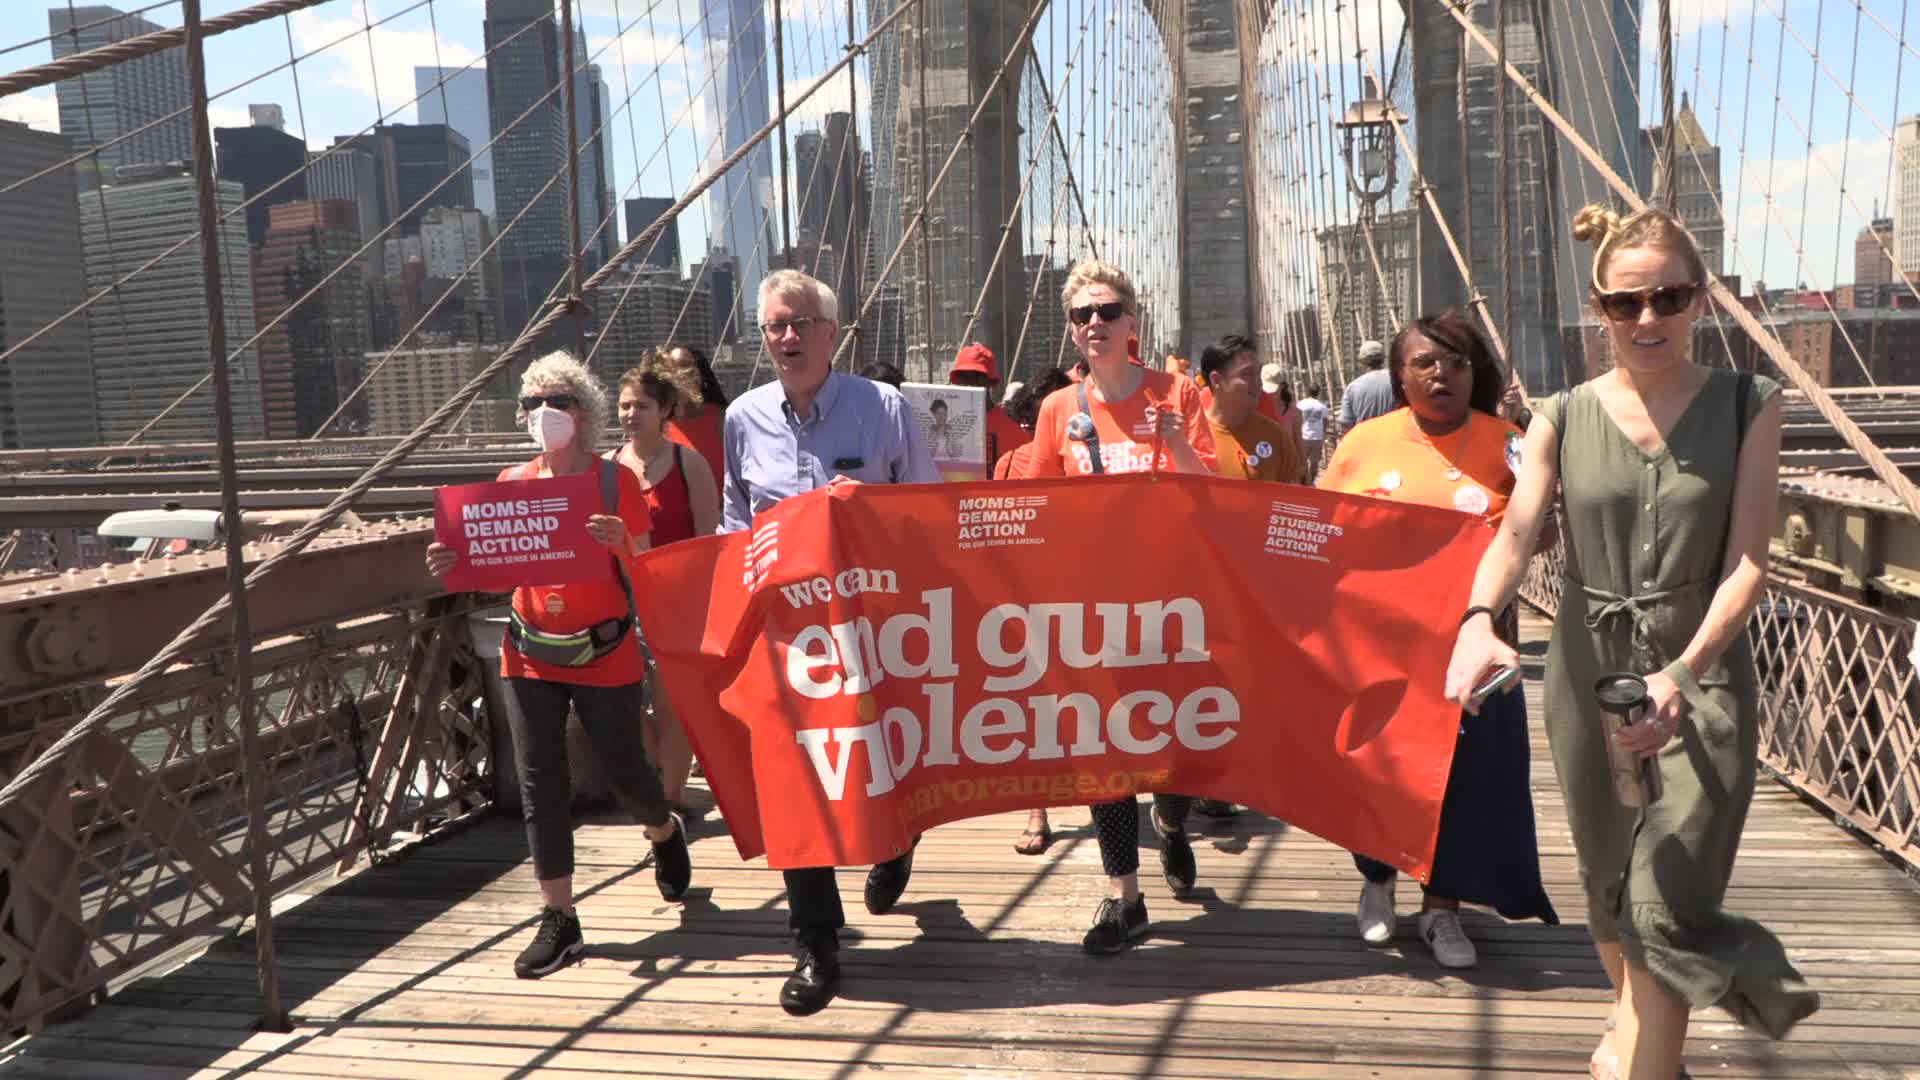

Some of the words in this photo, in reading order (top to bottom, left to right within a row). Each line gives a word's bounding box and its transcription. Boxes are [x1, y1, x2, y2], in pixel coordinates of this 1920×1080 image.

[1078, 452, 1168, 474] oange
[462, 500, 529, 520] MOMS
[960, 497, 1015, 510] MOMS
[959, 508, 1036, 525] DEMAND
[1270, 514, 1344, 536] STUDENTS
[464, 516, 559, 538] DEMAND
[959, 523, 1026, 539] ACTION
[1267, 525, 1328, 544] DEMAND
[468, 534, 550, 555] ACTION
[1265, 536, 1318, 553] ACTION
[540, 550, 576, 561] AMERICA
[780, 575, 832, 609] we
[835, 567, 900, 599] can
[787, 587, 959, 698] end
[976, 597, 1211, 692] gun
[796, 682, 1240, 800] violence
